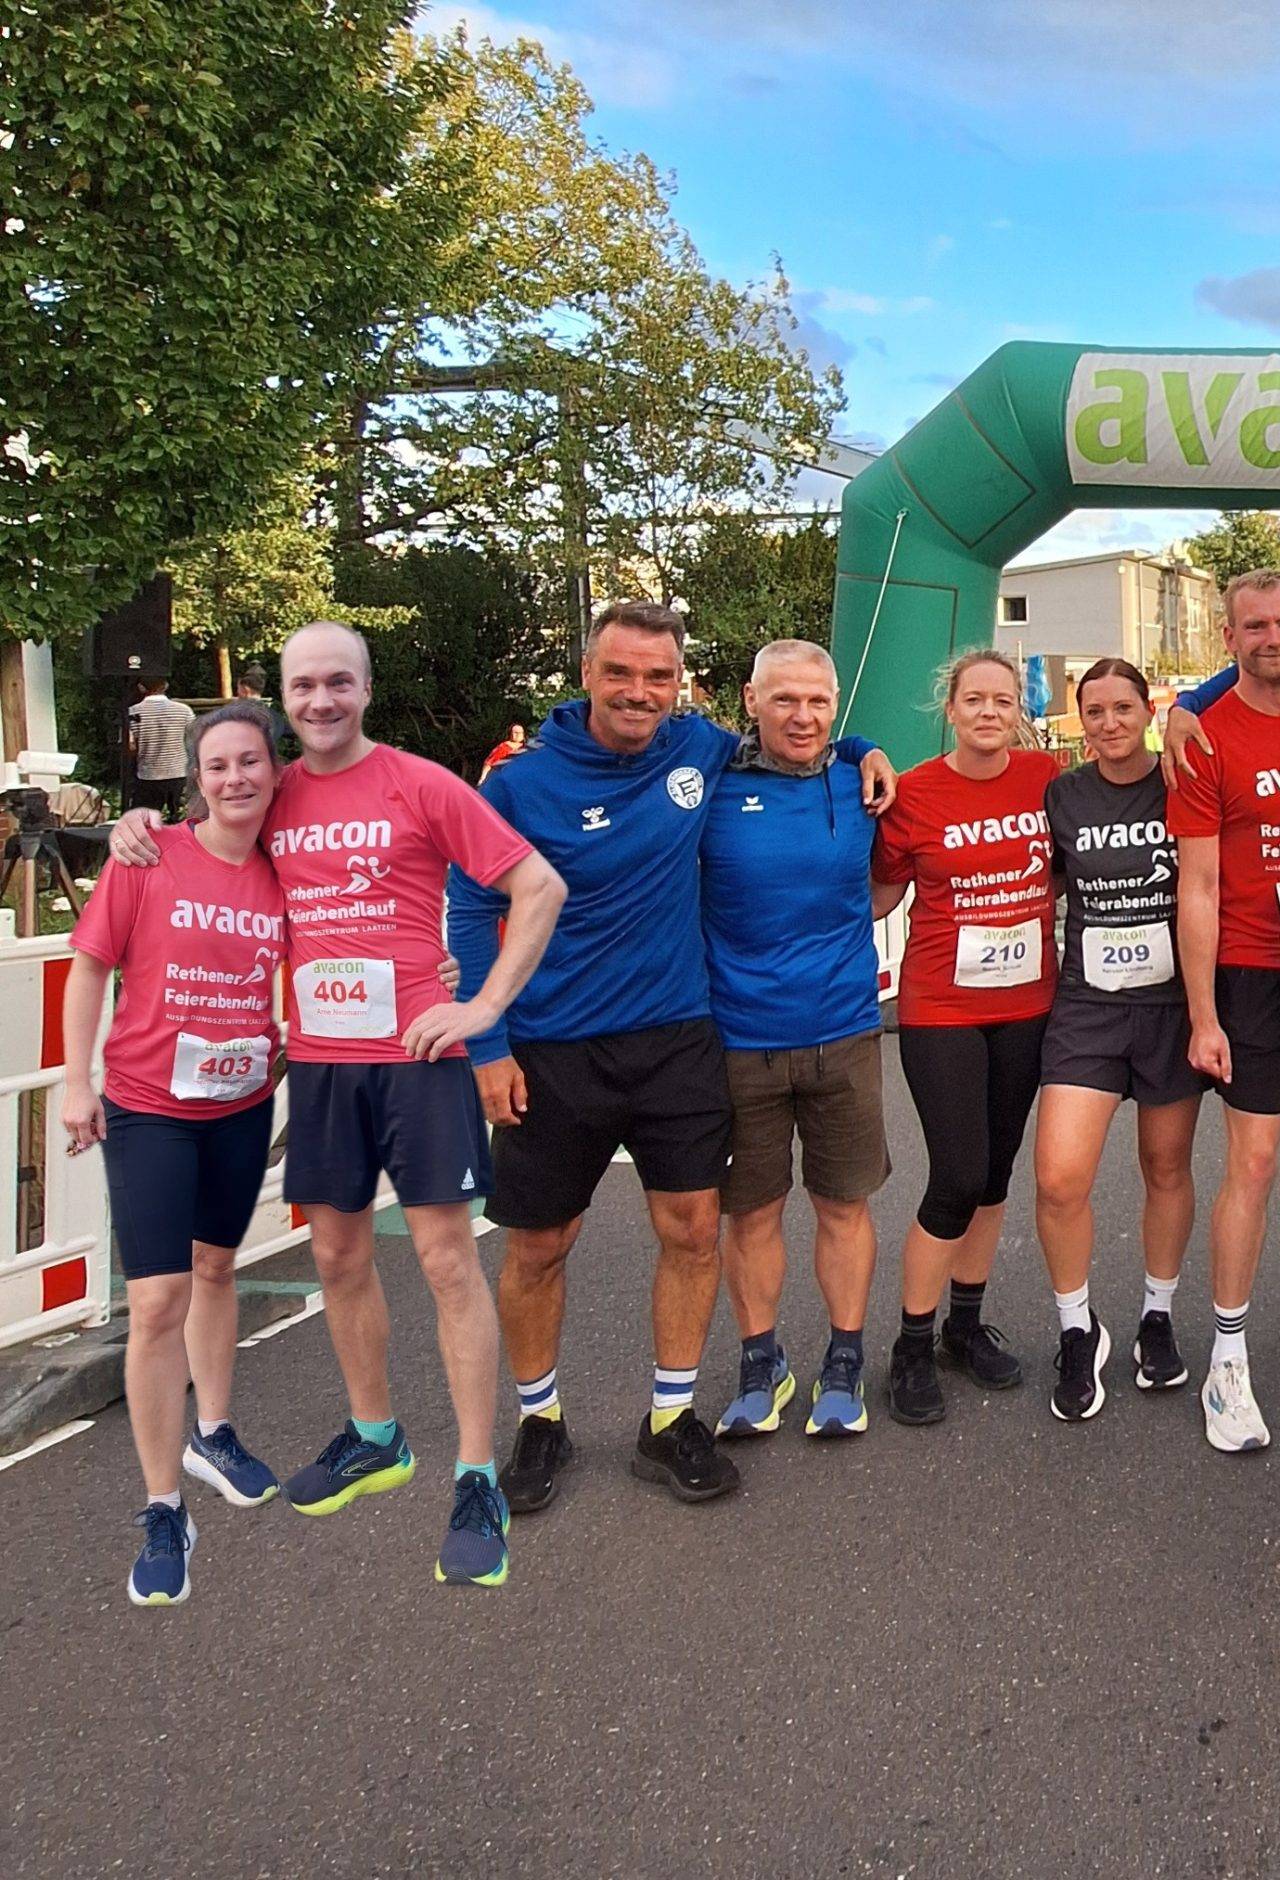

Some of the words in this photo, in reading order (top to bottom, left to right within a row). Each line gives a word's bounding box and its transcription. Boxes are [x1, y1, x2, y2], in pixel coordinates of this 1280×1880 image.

[271, 820, 391, 857] avacon
[944, 809, 1050, 849] avacon
[1076, 820, 1175, 852] avaco
[950, 869, 1022, 889] Rethener
[1076, 877, 1144, 892] Rethener
[170, 899, 285, 943] avacon
[984, 927, 1026, 941] avacon
[1102, 929, 1148, 941] avacon
[980, 941, 1026, 964] 210
[1102, 944, 1150, 964] 209
[166, 963, 243, 986] Rethener
[313, 962, 365, 974] avacon
[313, 980, 368, 1003] 404
[198, 1056, 254, 1077] 403
